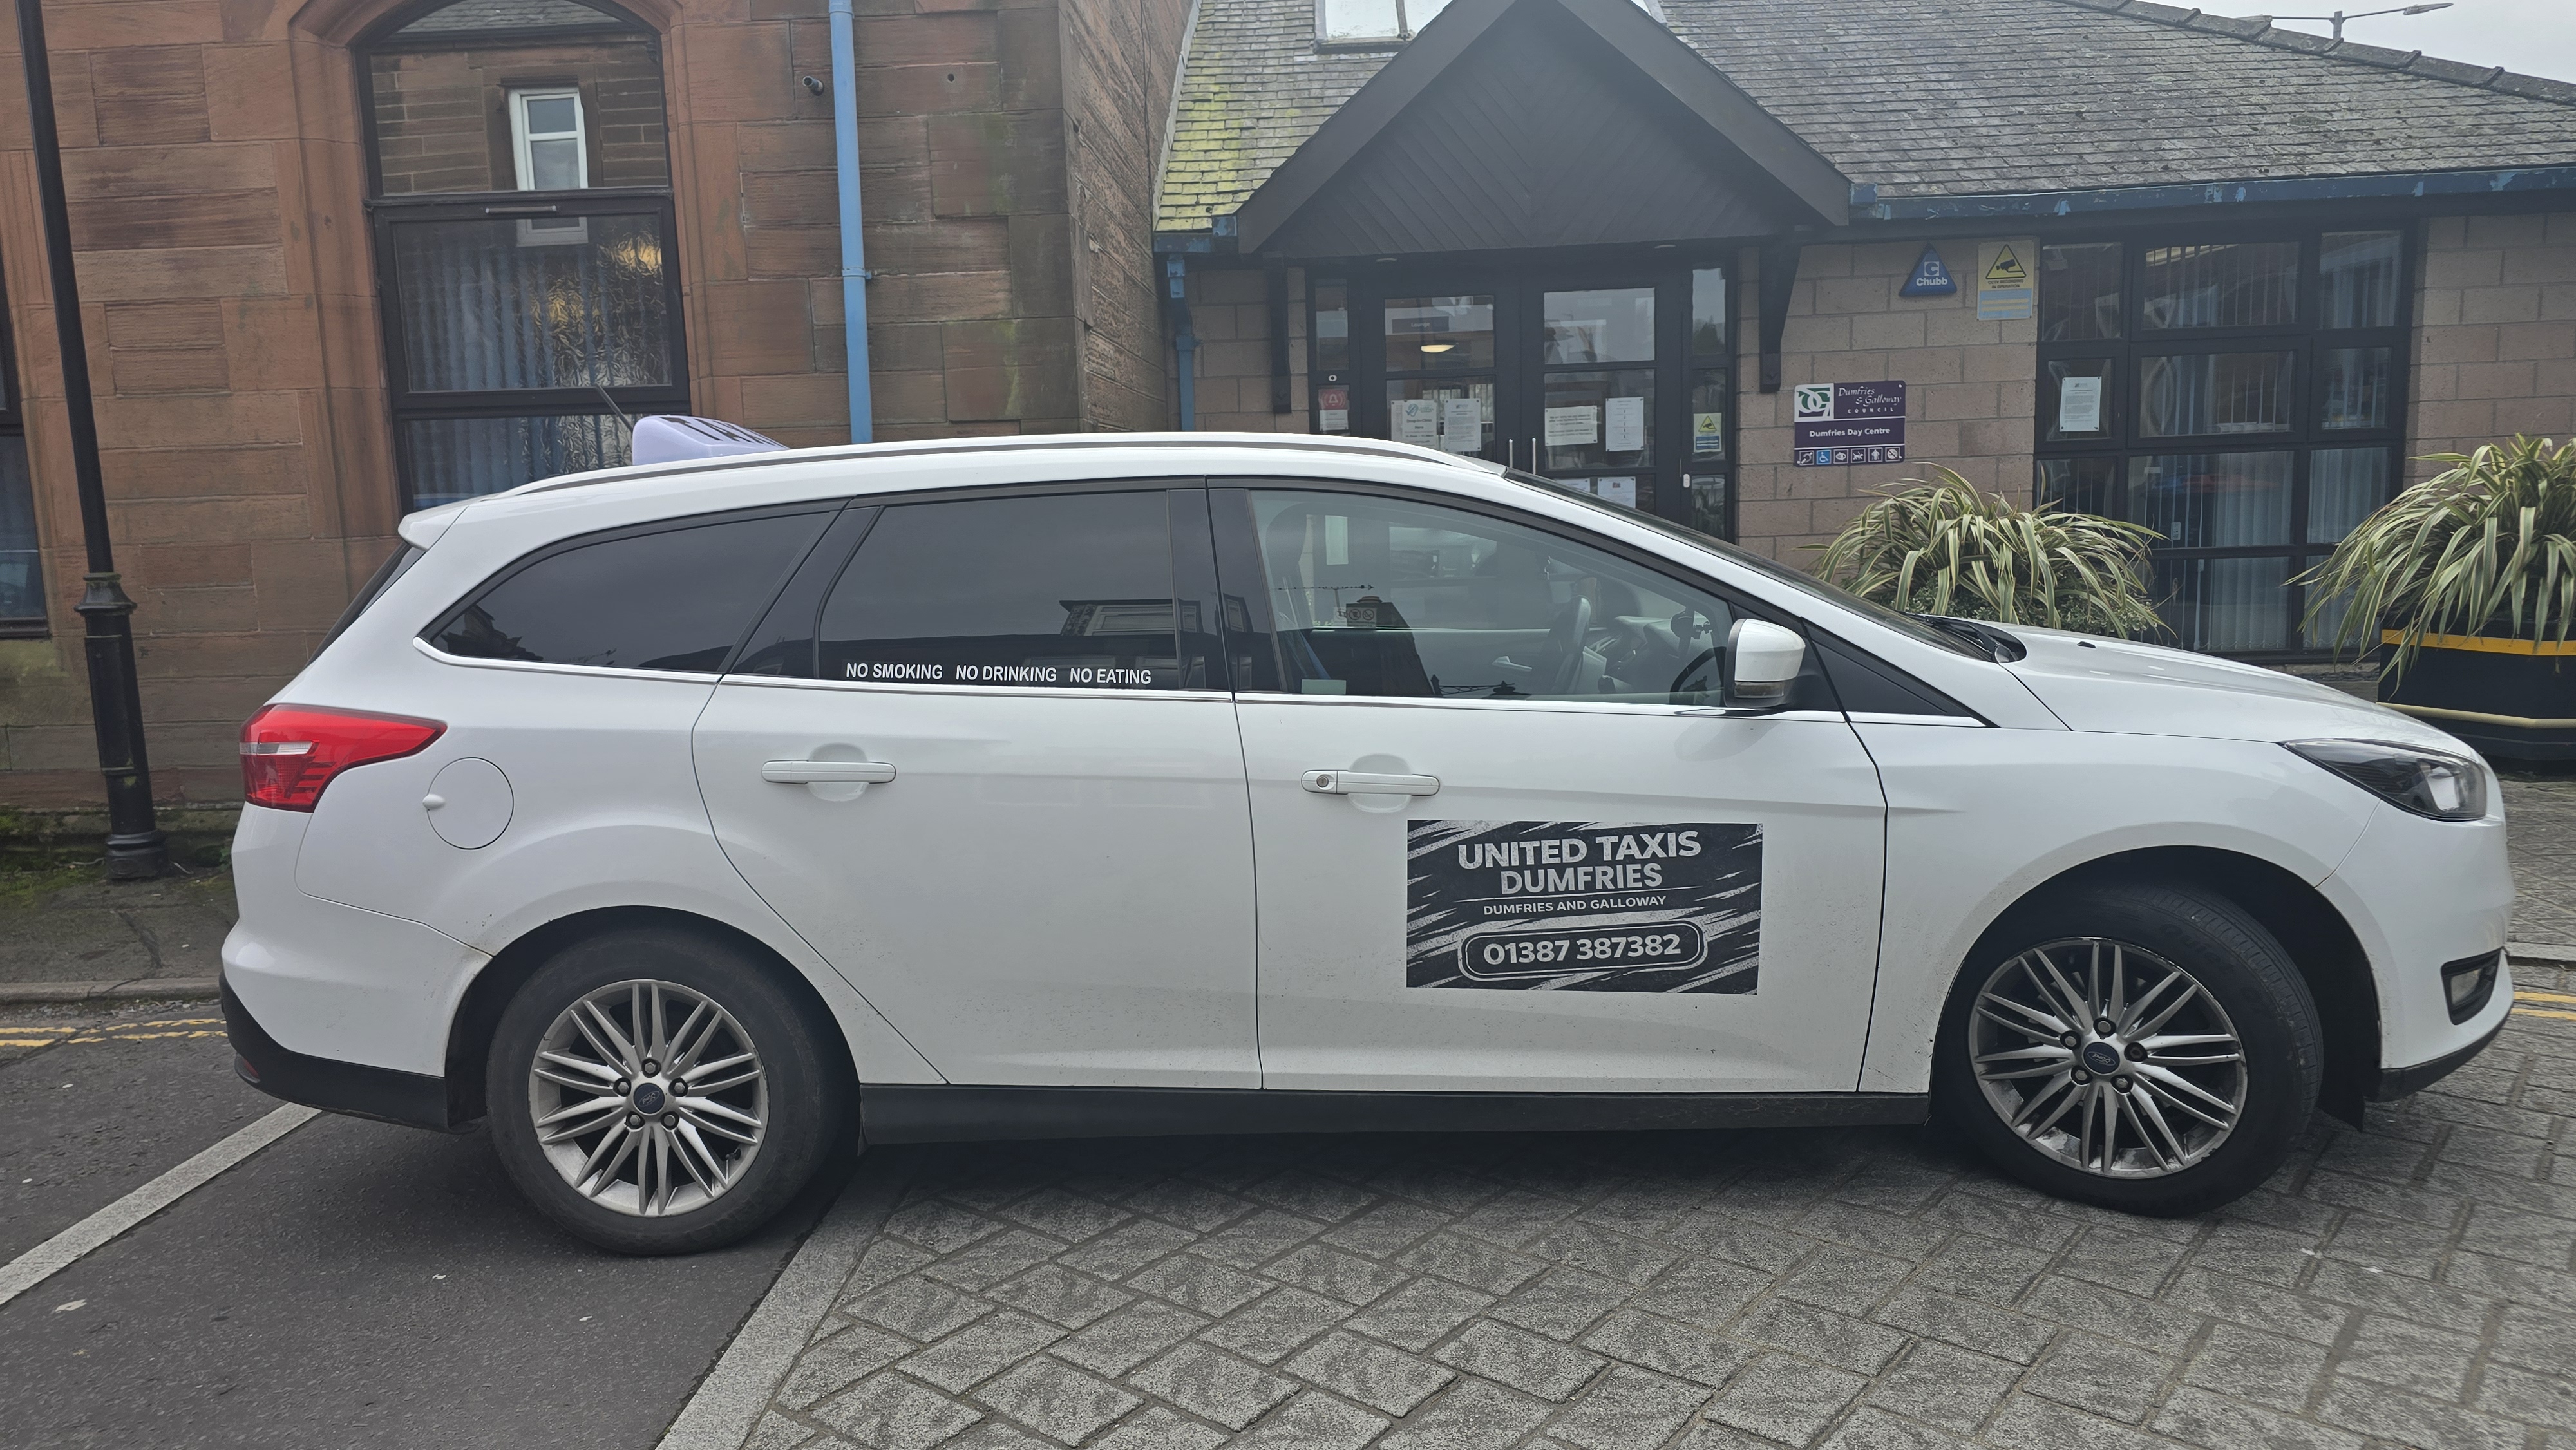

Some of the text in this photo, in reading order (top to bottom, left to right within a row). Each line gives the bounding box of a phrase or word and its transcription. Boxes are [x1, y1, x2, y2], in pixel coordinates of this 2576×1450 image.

[1917, 277, 1947, 287] Chubb
[1839, 386, 1875, 397] Dumfries
[1863, 394, 1902, 407] Galloway
[1810, 429, 1845, 437] Dumfries
[846, 663, 943, 680] NO SMOKING
[956, 665, 1057, 683] NO DRINKING
[1070, 667, 1151, 684] NO EATING
[1458, 831, 1701, 870] UNITED TAXIS
[1501, 863, 1662, 895] DUMFRIES
[1483, 896, 1667, 916] DUMFRIES AND GALLOWAY
[1483, 934, 1681, 965] 01387 387382
[2092, 1053, 2111, 1065] Ford
